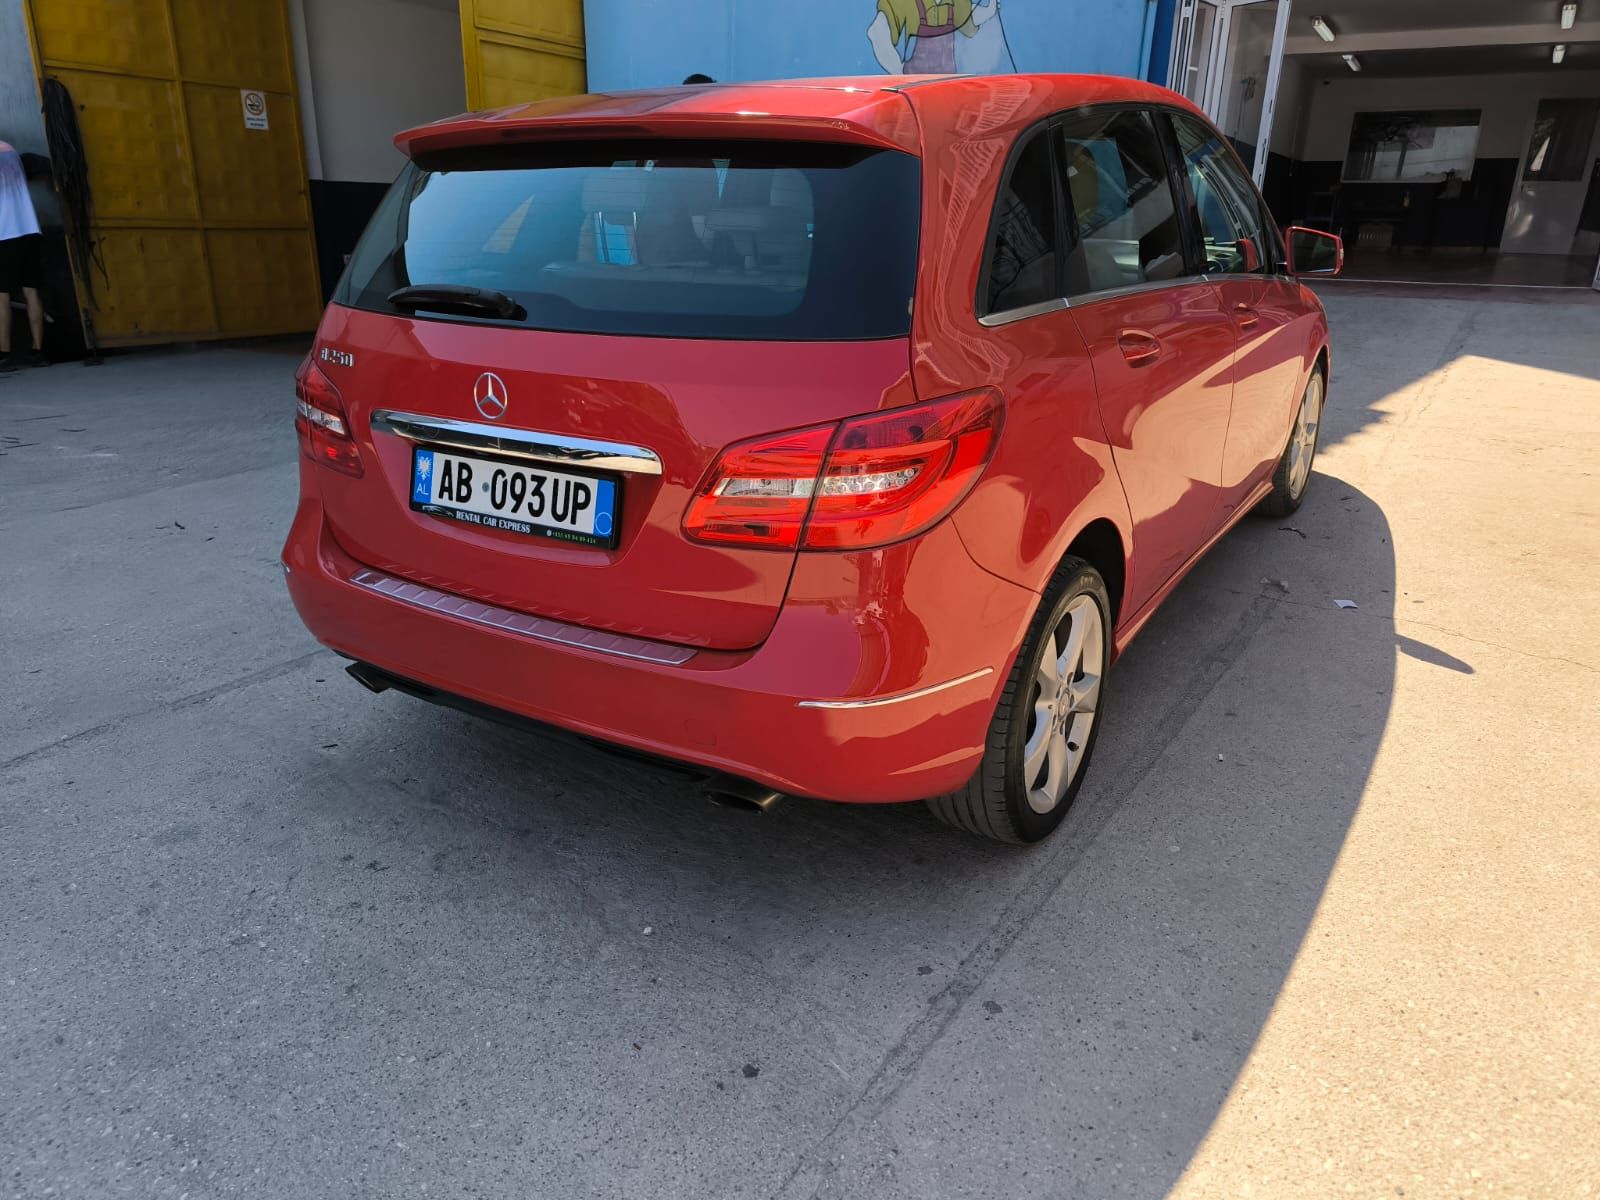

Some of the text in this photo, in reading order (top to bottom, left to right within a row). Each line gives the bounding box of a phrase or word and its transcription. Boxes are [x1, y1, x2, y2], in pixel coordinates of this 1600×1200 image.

[416, 483, 429, 495] AL
[438, 459, 473, 503] AB
[456, 511, 531, 534] RENTAL CAR EXPRESS
